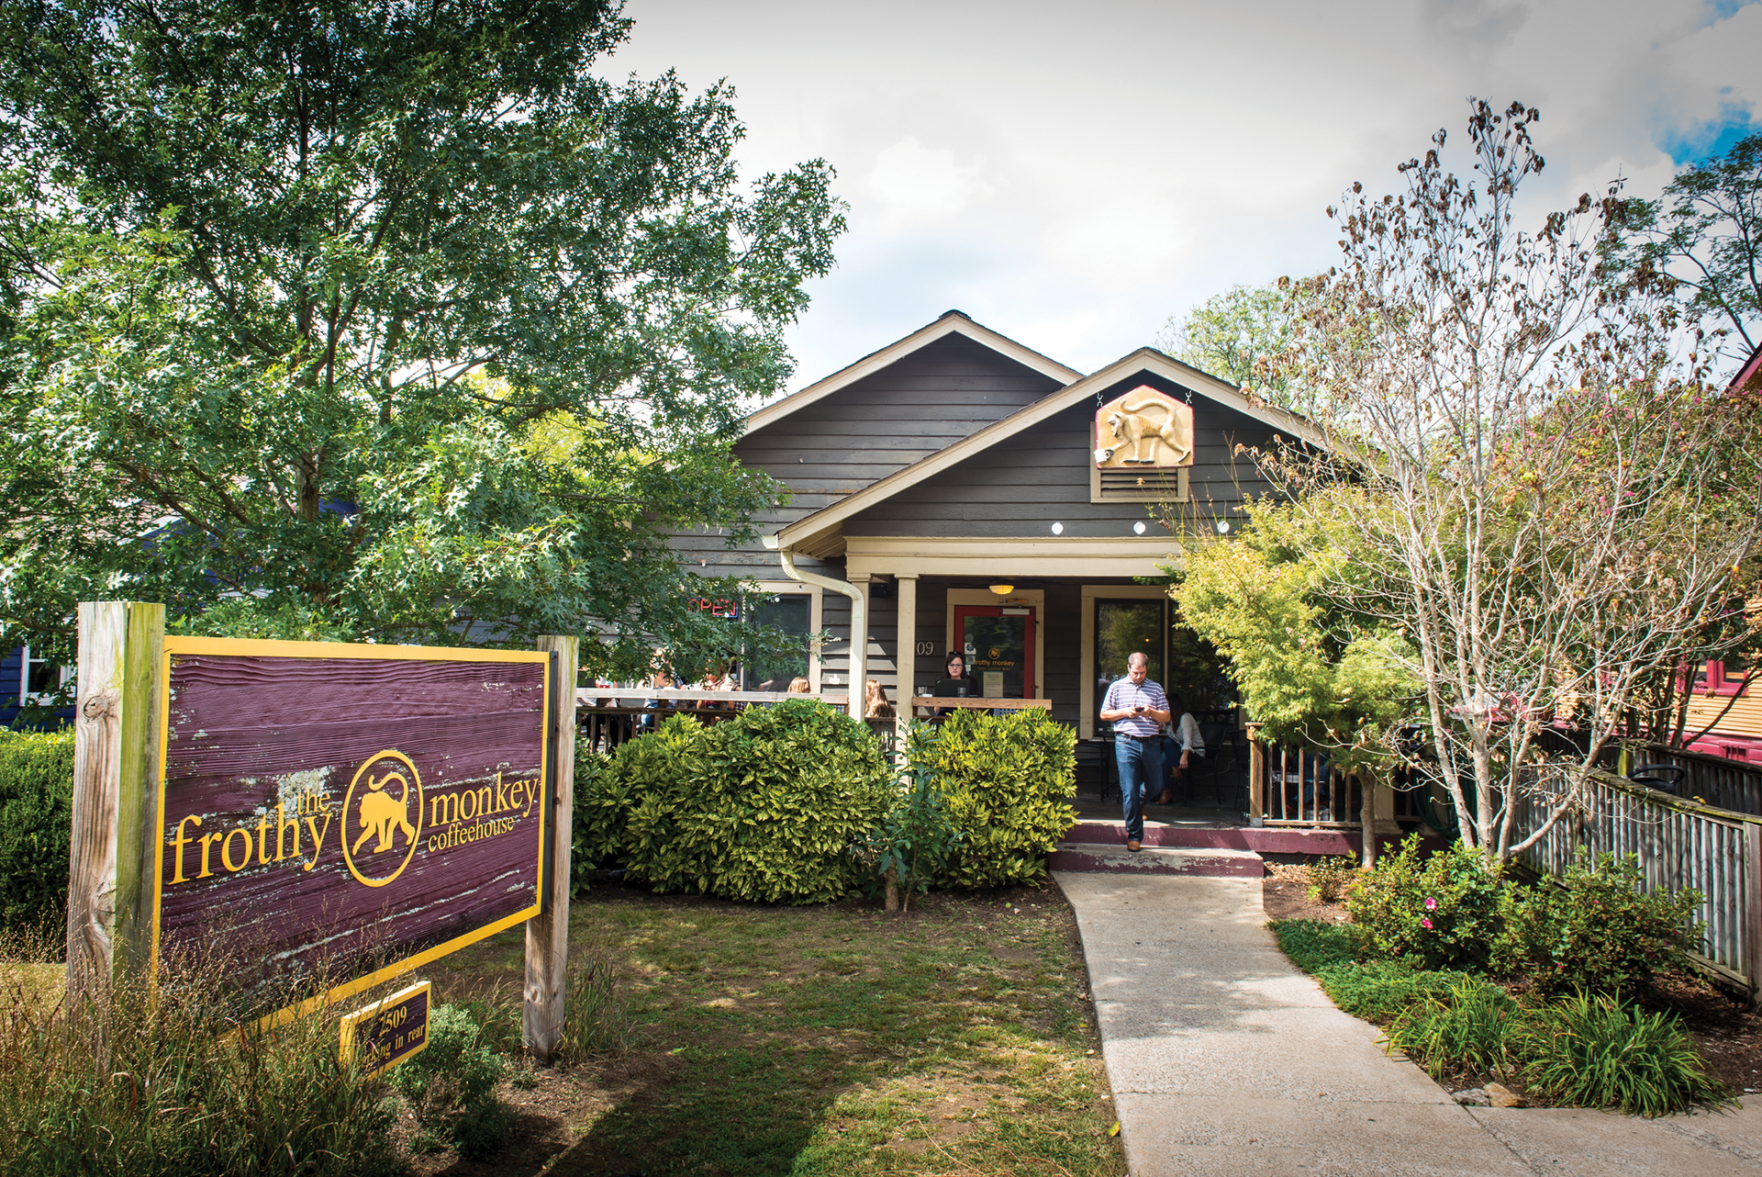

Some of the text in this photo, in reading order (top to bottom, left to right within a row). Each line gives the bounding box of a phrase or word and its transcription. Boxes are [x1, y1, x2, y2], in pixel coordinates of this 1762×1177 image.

[914, 641, 934, 655] 09
[992, 659, 1015, 668] monkey
[297, 786, 332, 815] the
[168, 771, 539, 885] frothy monkey
[428, 816, 514, 853] coffeehouse
[394, 1033, 404, 1050] in
[407, 1024, 425, 1043] rear
